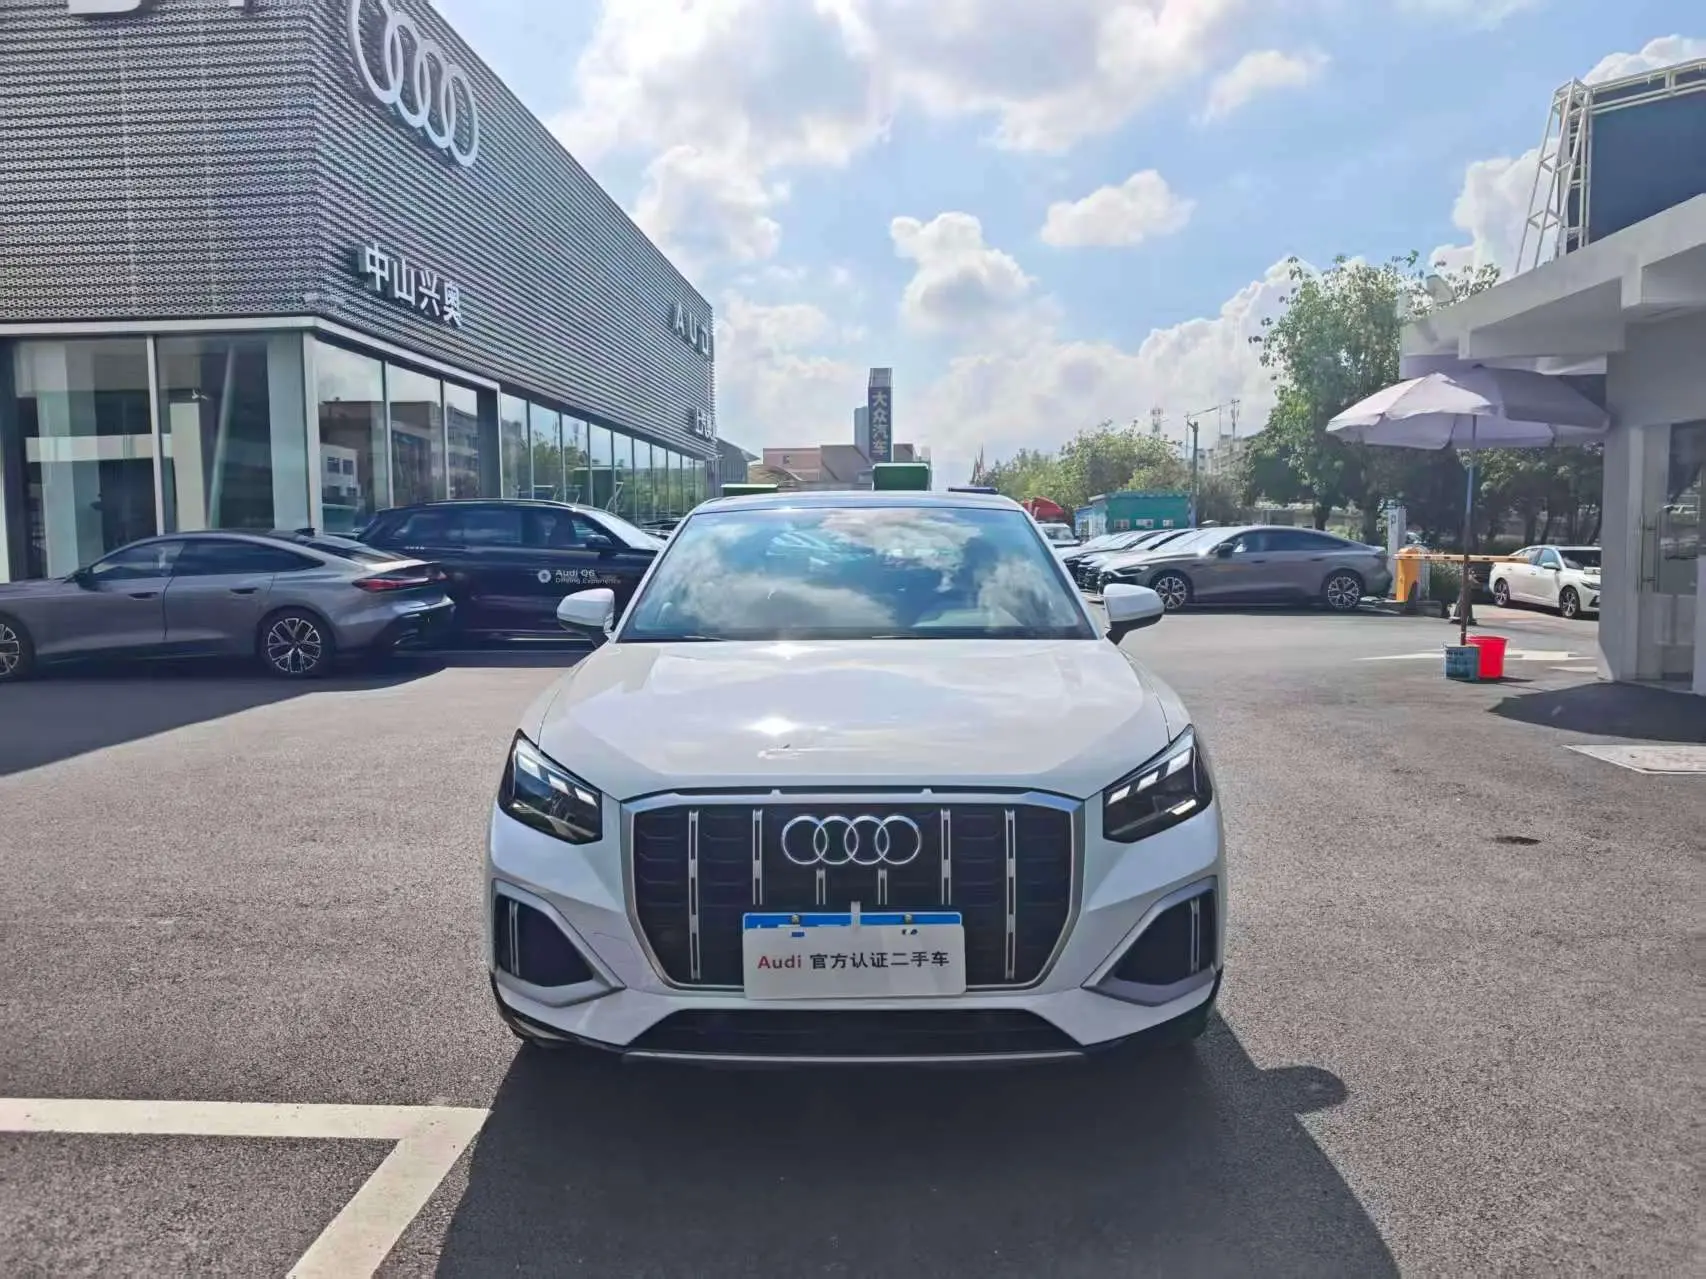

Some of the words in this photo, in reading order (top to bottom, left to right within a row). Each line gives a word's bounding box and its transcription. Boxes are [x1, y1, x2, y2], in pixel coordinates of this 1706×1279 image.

[364, 242, 462, 327] 中山兴奥
[871, 391, 889, 456] 大众汽车
[555, 569, 578, 577] Audi
[757, 954, 802, 969] Audi
[809, 951, 950, 970] 官方认证二手车
